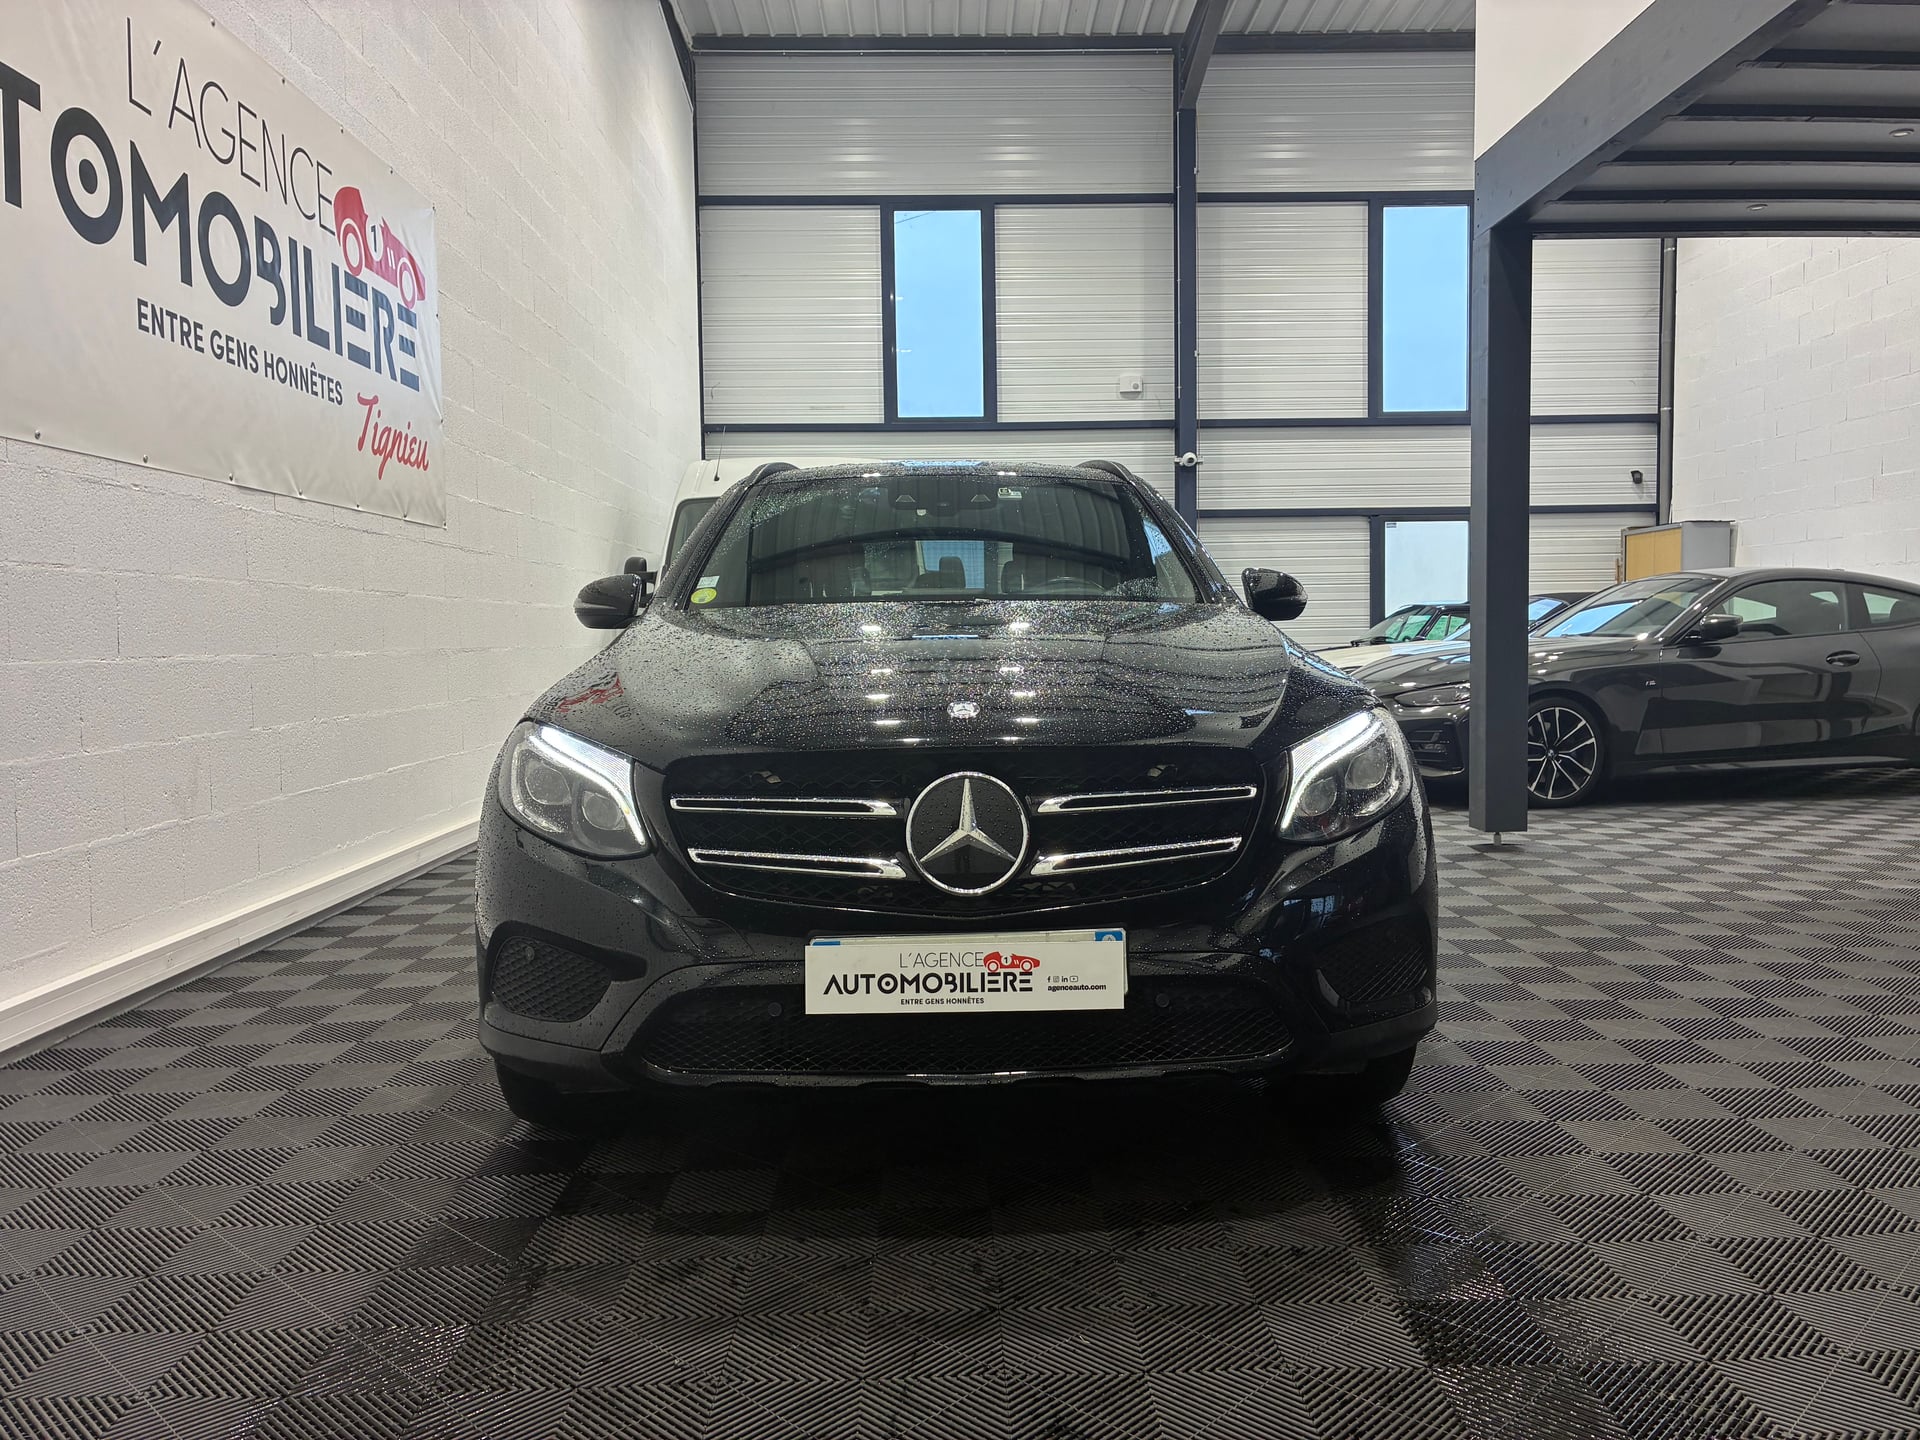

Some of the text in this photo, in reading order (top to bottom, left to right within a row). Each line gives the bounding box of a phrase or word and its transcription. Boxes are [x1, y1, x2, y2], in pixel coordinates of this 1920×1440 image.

[126, 17, 336, 237] L'AGENCE
[137, 298, 343, 406] ENTRE GENS HONNÊTES
[356, 391, 430, 481] Tignieu
[899, 951, 984, 969] L'AGENCE
[946, 996, 985, 1004] HONNÊTES
[1047, 984, 1107, 992] agenceauto.com
